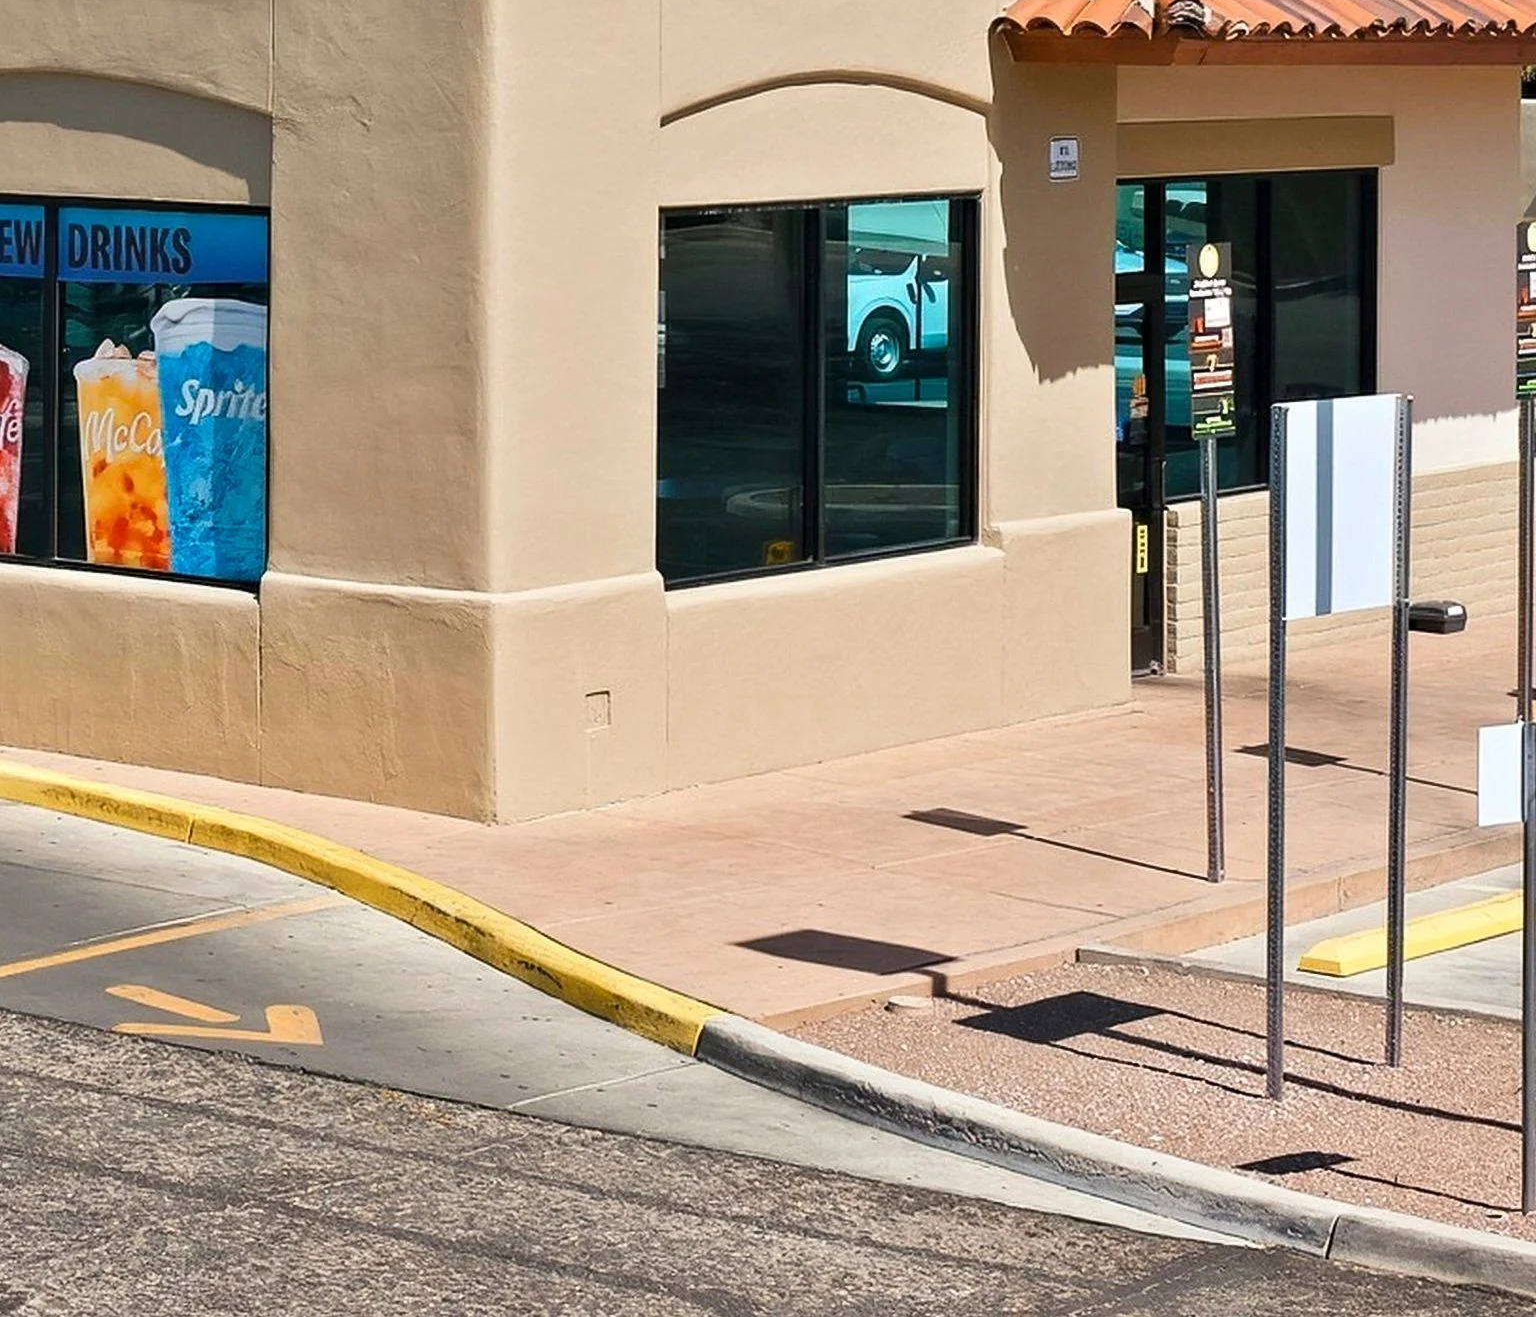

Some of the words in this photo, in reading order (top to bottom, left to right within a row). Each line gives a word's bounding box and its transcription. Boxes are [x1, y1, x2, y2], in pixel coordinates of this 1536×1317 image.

[67, 222, 192, 276] DRINKS
[175, 378, 266, 426] Sprite
[84, 407, 165, 463] McCa
